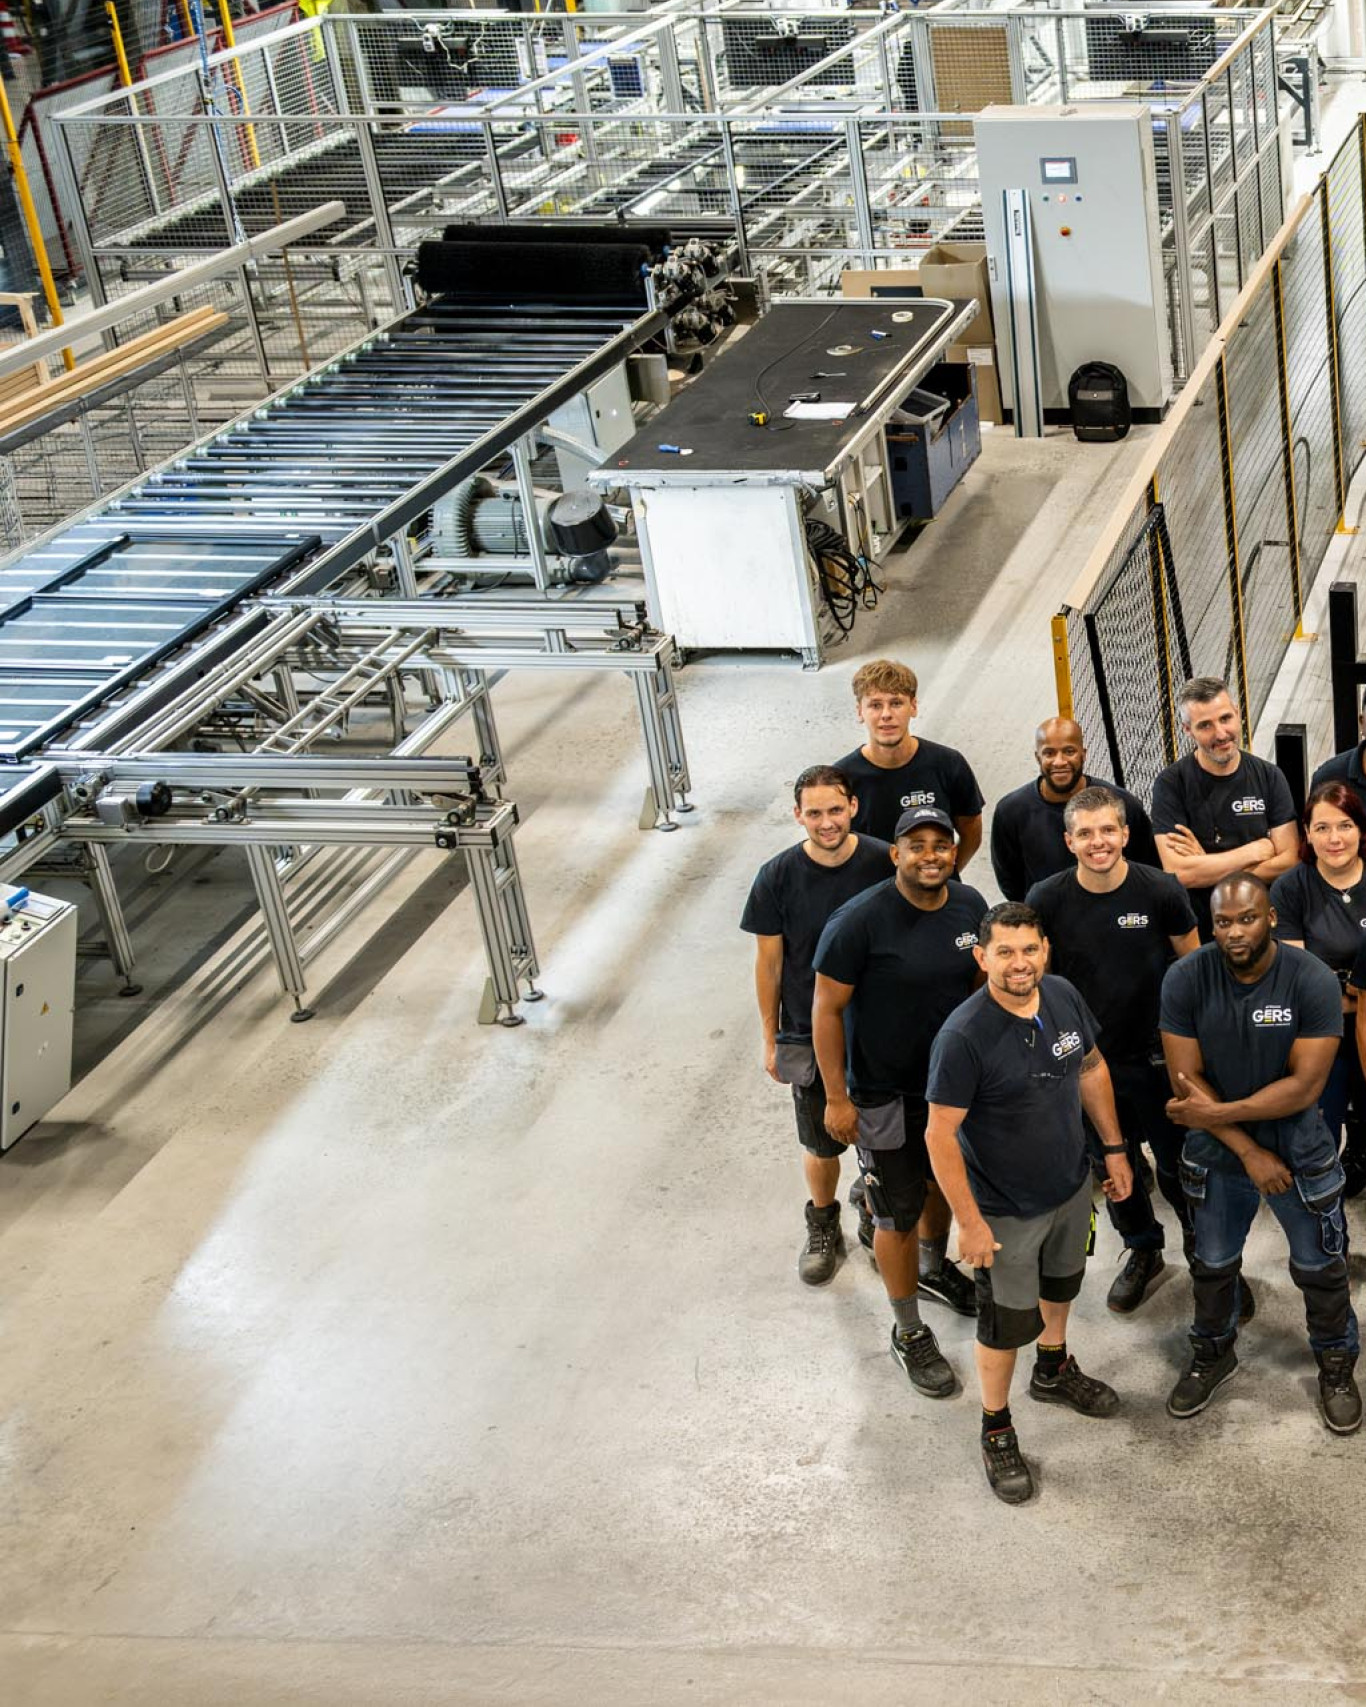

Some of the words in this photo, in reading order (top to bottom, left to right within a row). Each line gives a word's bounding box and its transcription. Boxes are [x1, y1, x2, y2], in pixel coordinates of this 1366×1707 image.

[900, 792, 935, 807] GERS
[1231, 799, 1266, 813] GERS
[1117, 915, 1149, 927] GERS
[955, 934, 979, 948] GERS
[1252, 1008, 1292, 1024] GERS
[1052, 1031, 1080, 1056] GERS
